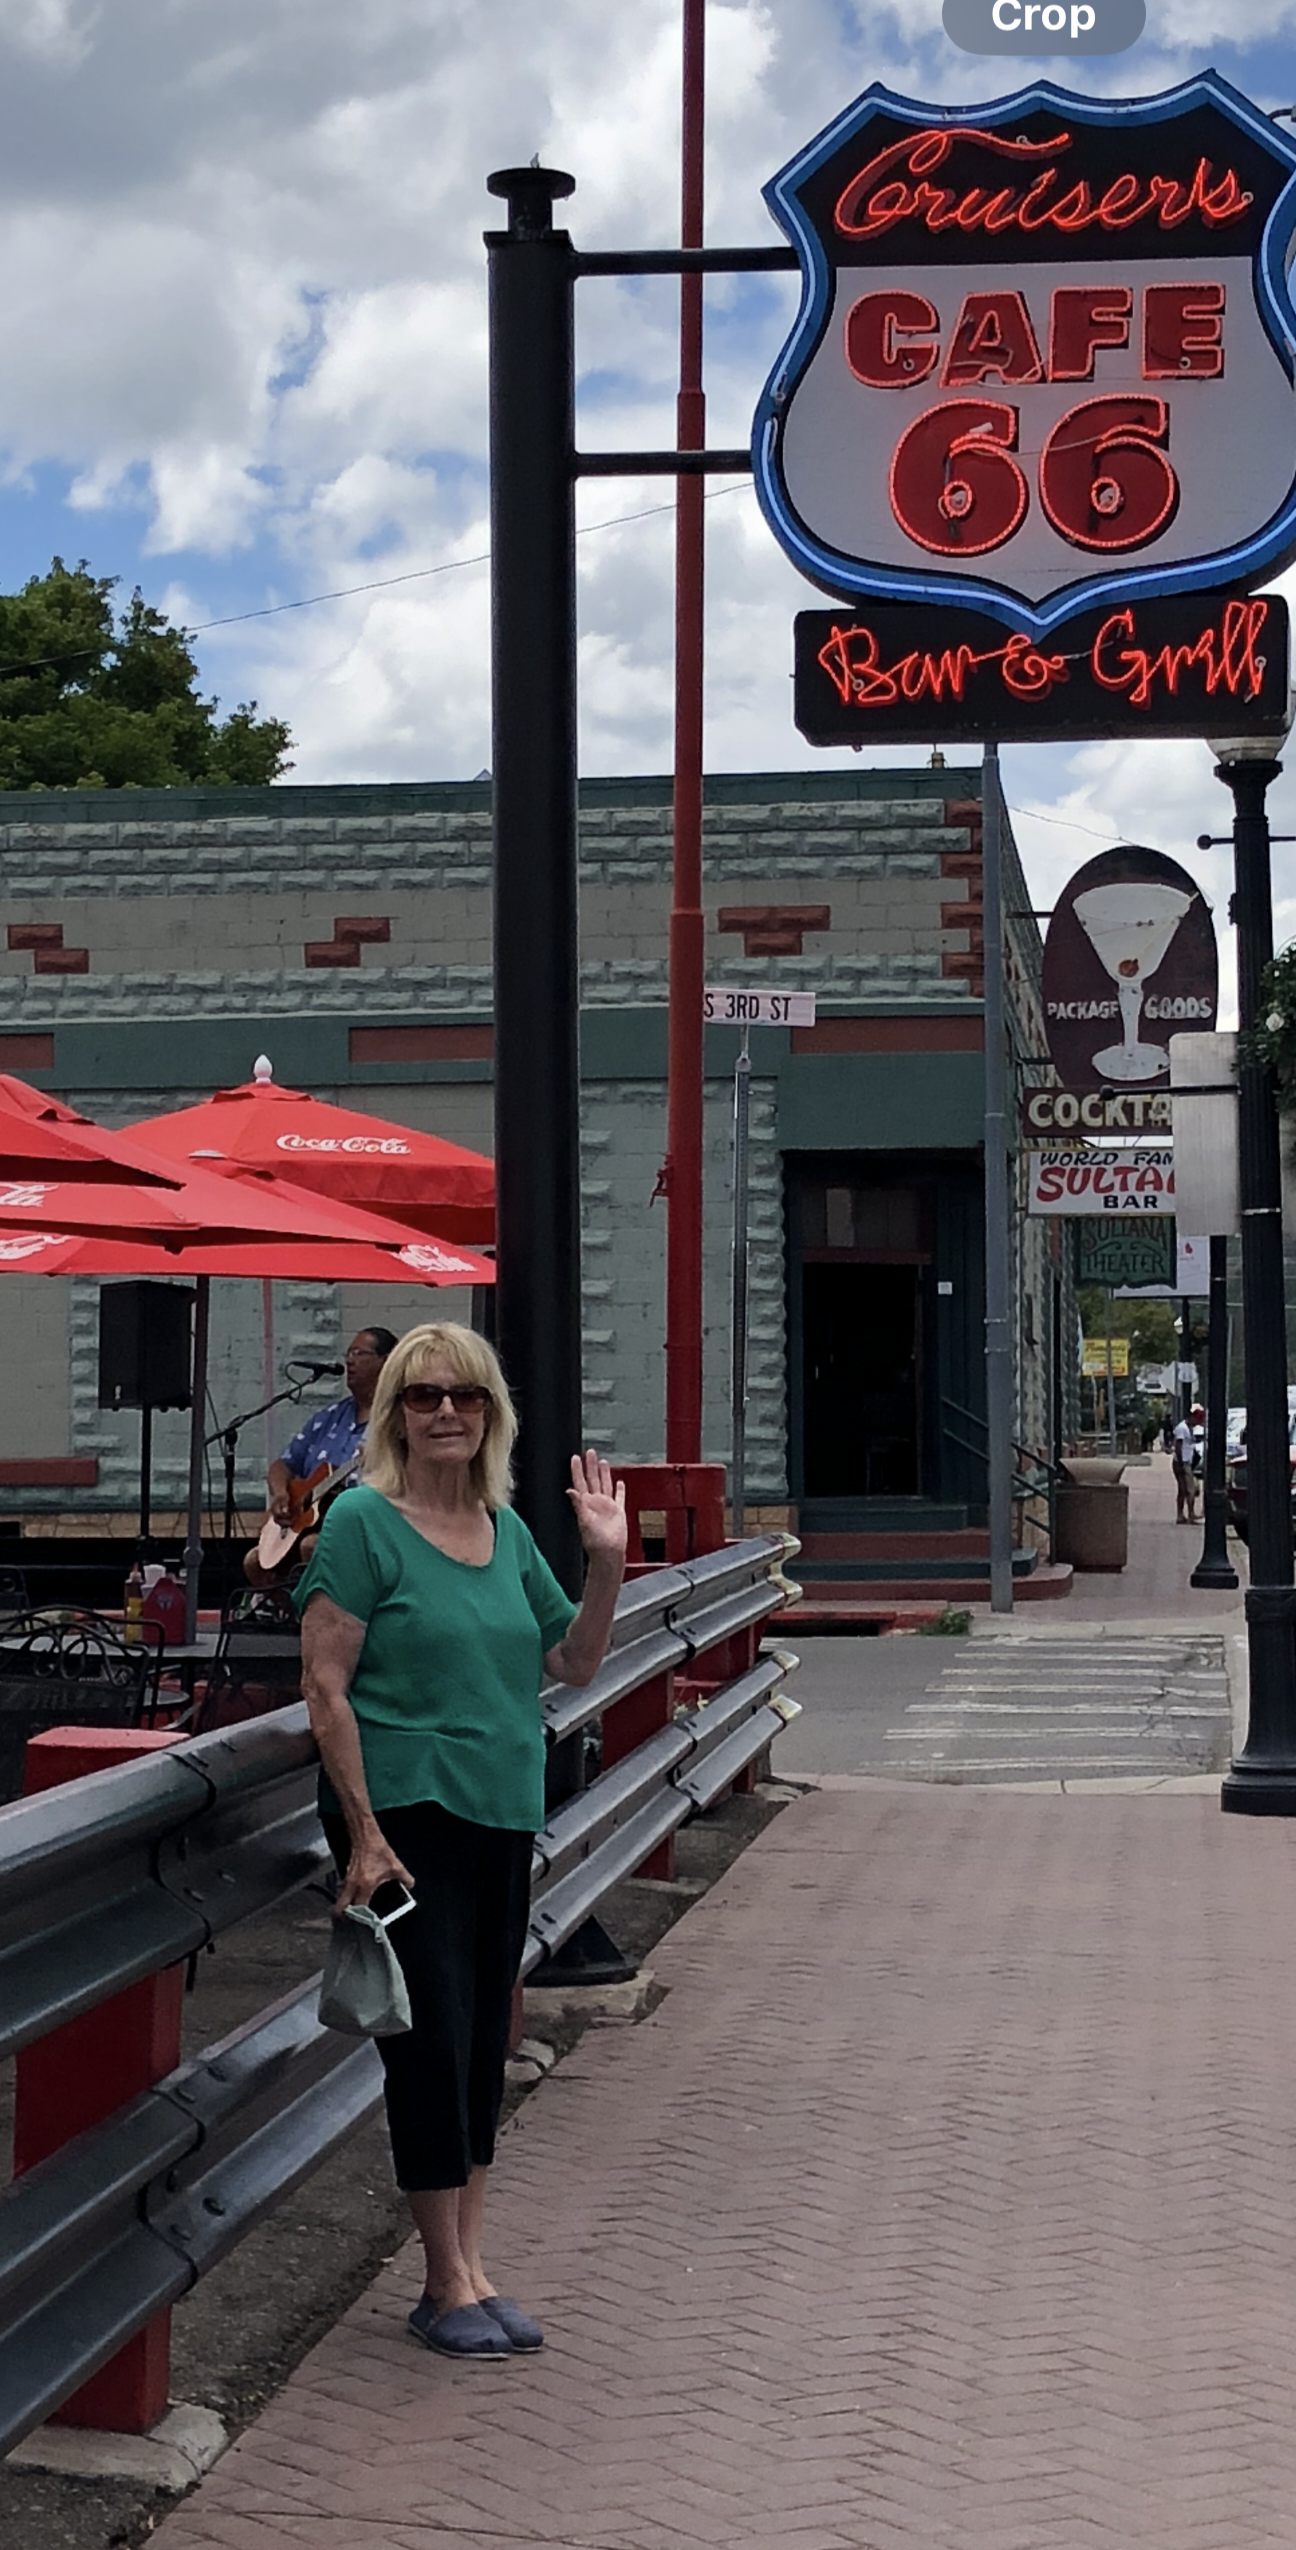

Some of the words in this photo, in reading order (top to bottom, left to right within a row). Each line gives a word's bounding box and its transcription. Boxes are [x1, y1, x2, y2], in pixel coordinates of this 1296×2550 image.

[843, 281, 1226, 391] CAFE
[888, 394, 1181, 557] 66
[818, 624, 979, 706] Bar
[1002, 633, 1069, 702] &
[1093, 601, 1268, 710] Grill
[704, 993, 714, 1018] S
[725, 994, 760, 1019] 3RD
[770, 996, 792, 1021] ST
[1047, 1000, 1119, 1020] PACKAGE
[1144, 996, 1213, 1019] GOODS
[276, 1133, 411, 1155] Coca-Cola
[1040, 1152, 1119, 1166] WORLD
[1103, 1195, 1158, 1209] BAR
[1082, 1217, 1167, 1252] SULTANA
[1085, 1252, 1167, 1274] THEATER
